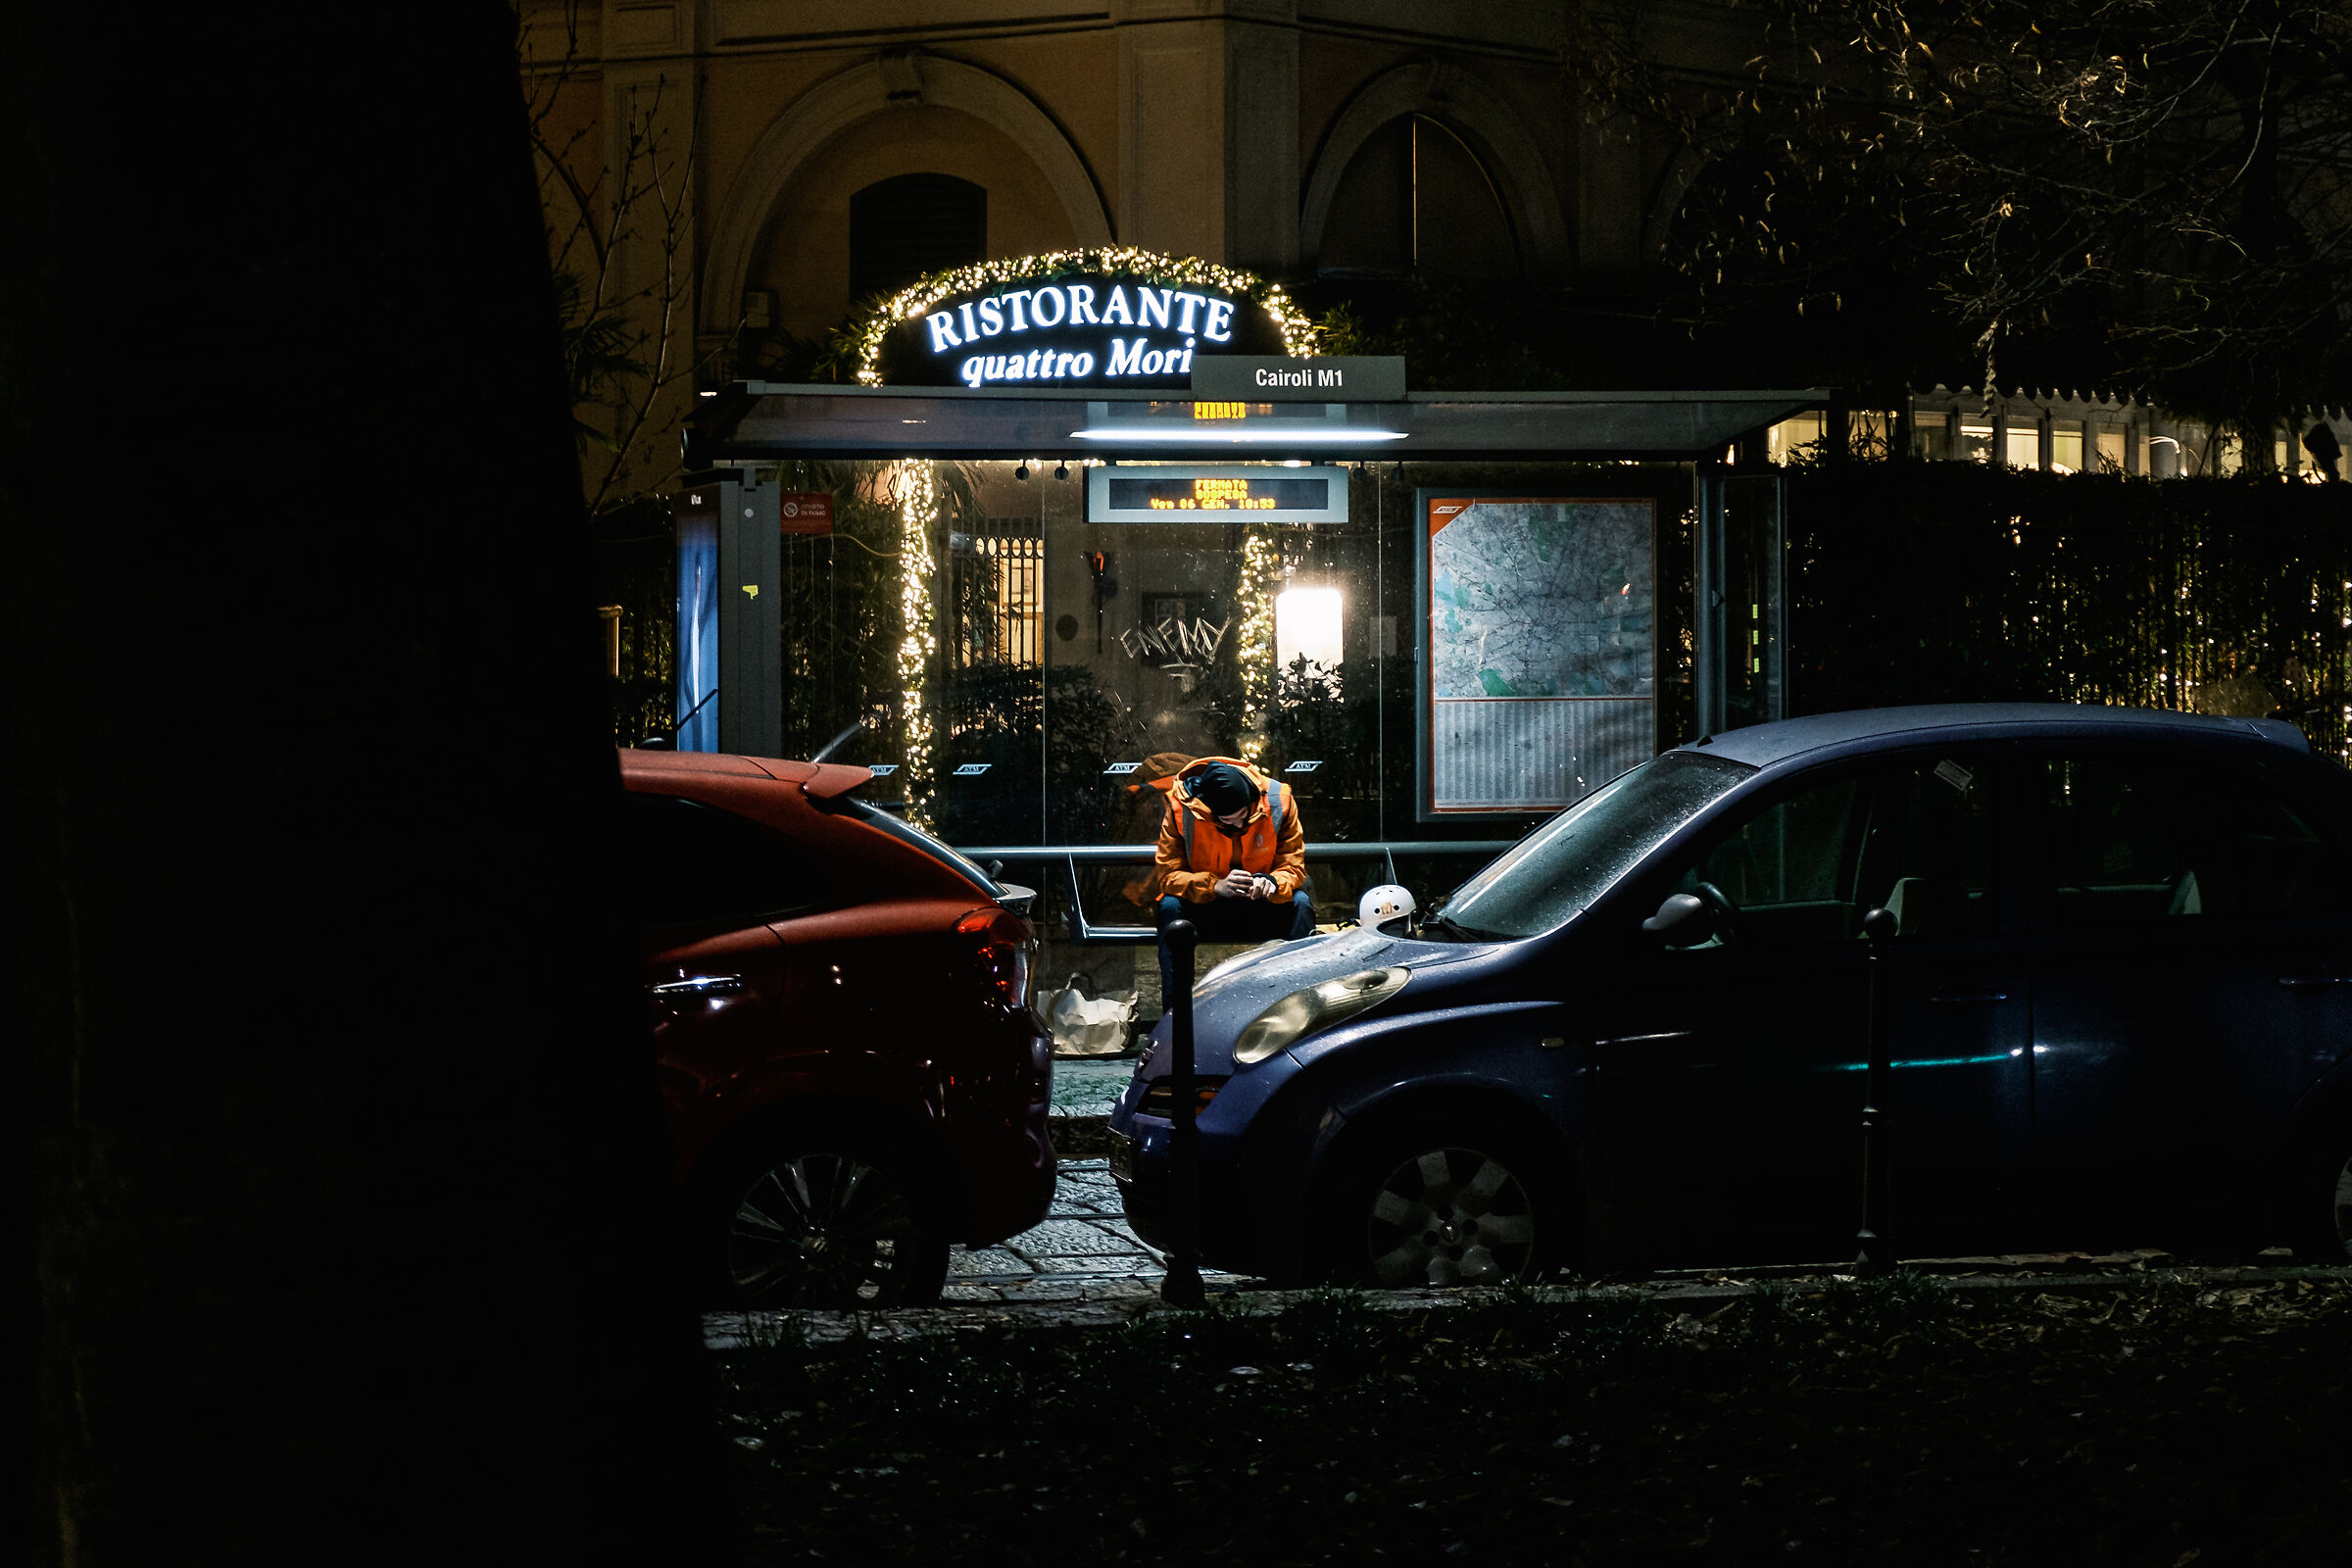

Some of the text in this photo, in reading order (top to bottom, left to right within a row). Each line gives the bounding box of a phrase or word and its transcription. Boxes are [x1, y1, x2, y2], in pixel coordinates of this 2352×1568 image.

[925, 284, 1235, 354] RISTORANTE
[960, 337, 1195, 388] quattro Mori
[1255, 368, 1343, 387] Cairoli M1
[1195, 479, 1248, 491] FERMATA
[1195, 489, 1248, 500] SOSPESA
[1150, 498, 1175, 510] Ven
[1179, 498, 1197, 510] 06
[1201, 498, 1230, 510] GEN.
